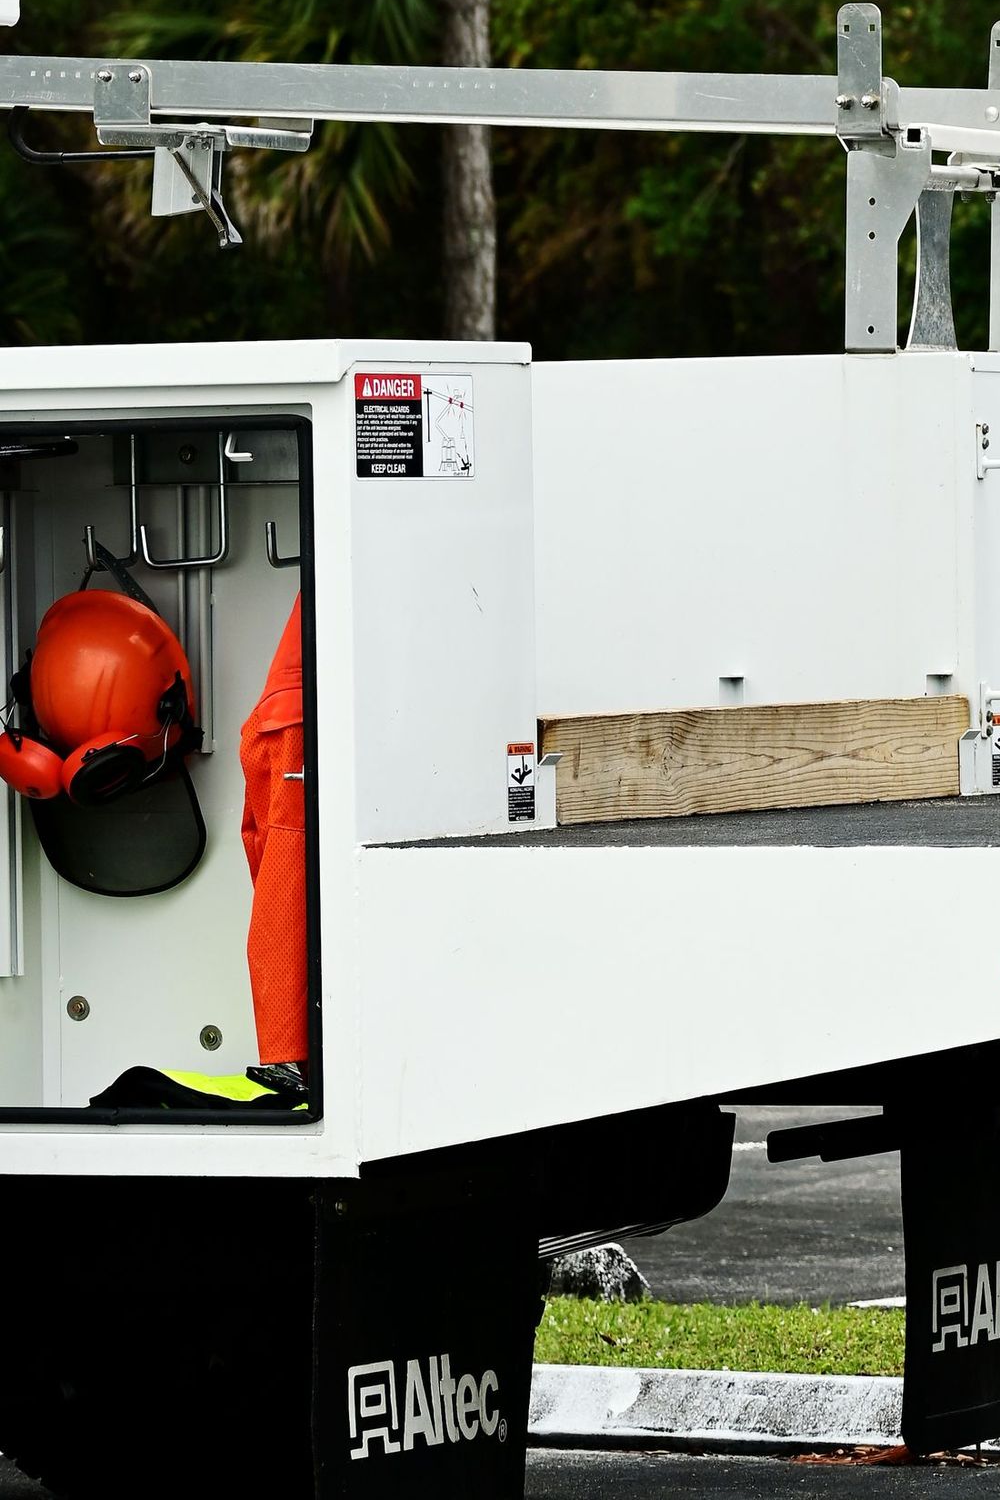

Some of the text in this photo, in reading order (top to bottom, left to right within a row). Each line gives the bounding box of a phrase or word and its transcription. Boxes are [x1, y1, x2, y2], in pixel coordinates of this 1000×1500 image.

[373, 379, 415, 397] DANGER
[372, 464, 406, 474] KEEP CLEAR
[403, 1353, 499, 1451] Altec
